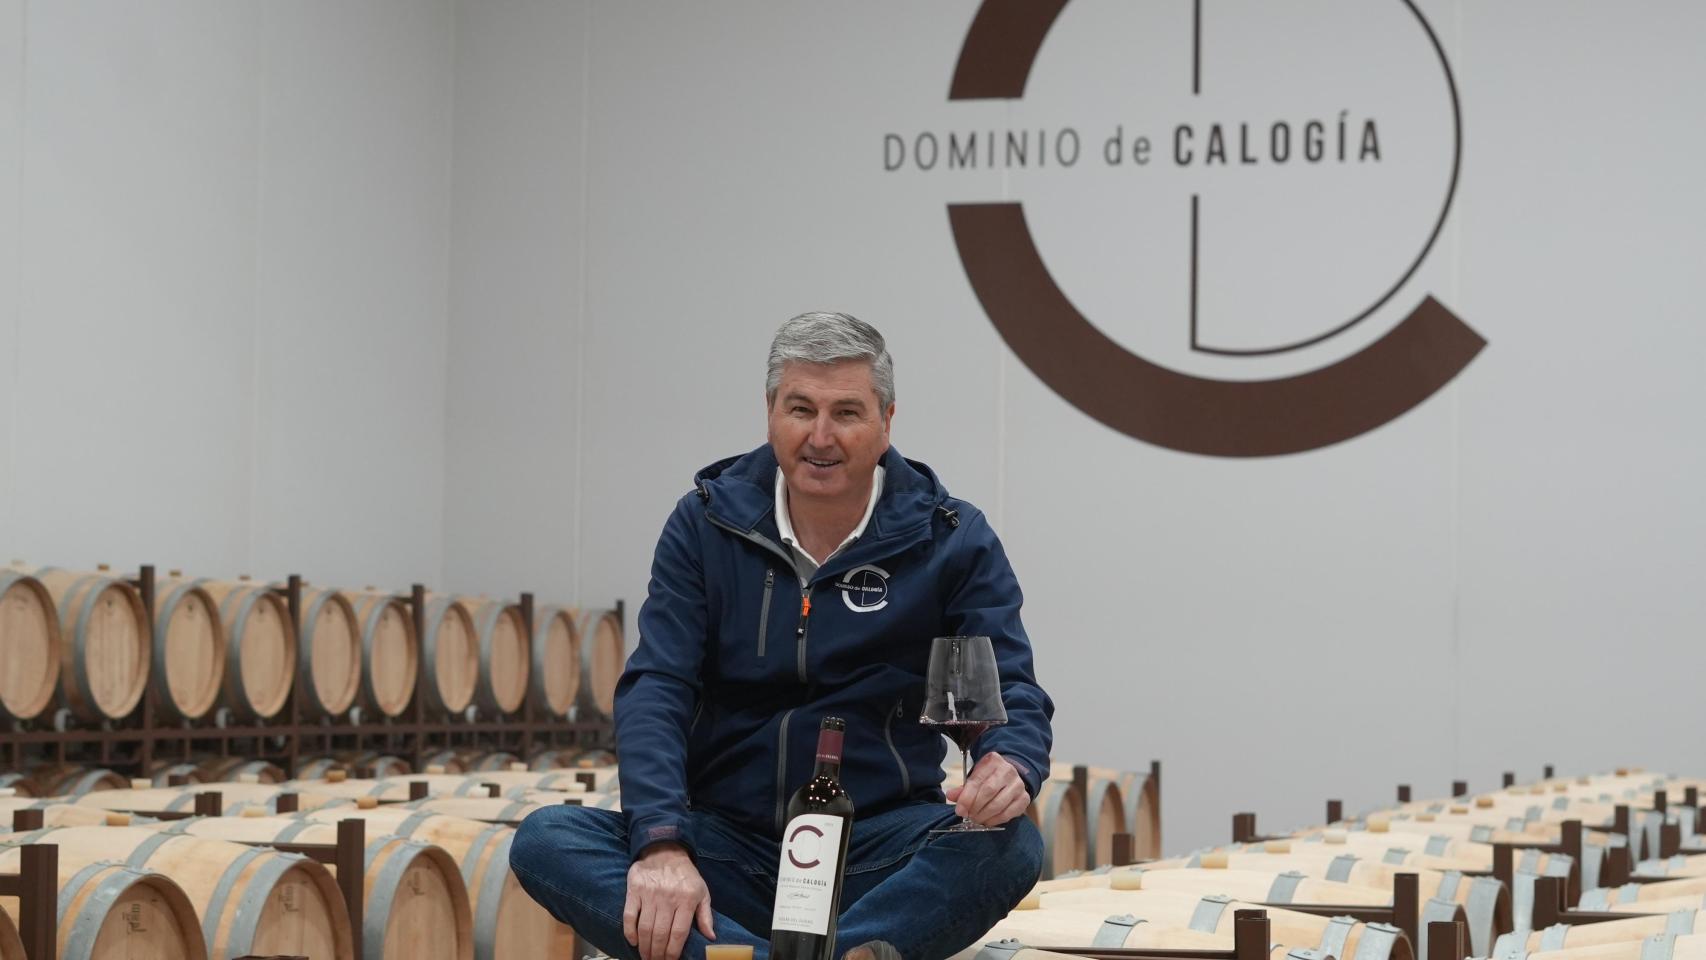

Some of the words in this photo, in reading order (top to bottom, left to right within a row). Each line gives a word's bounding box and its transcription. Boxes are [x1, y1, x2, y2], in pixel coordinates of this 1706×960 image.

[883, 130, 1081, 171] DOMINIO
[1103, 125, 1152, 167] de
[1173, 110, 1383, 166] CALOGÍA
